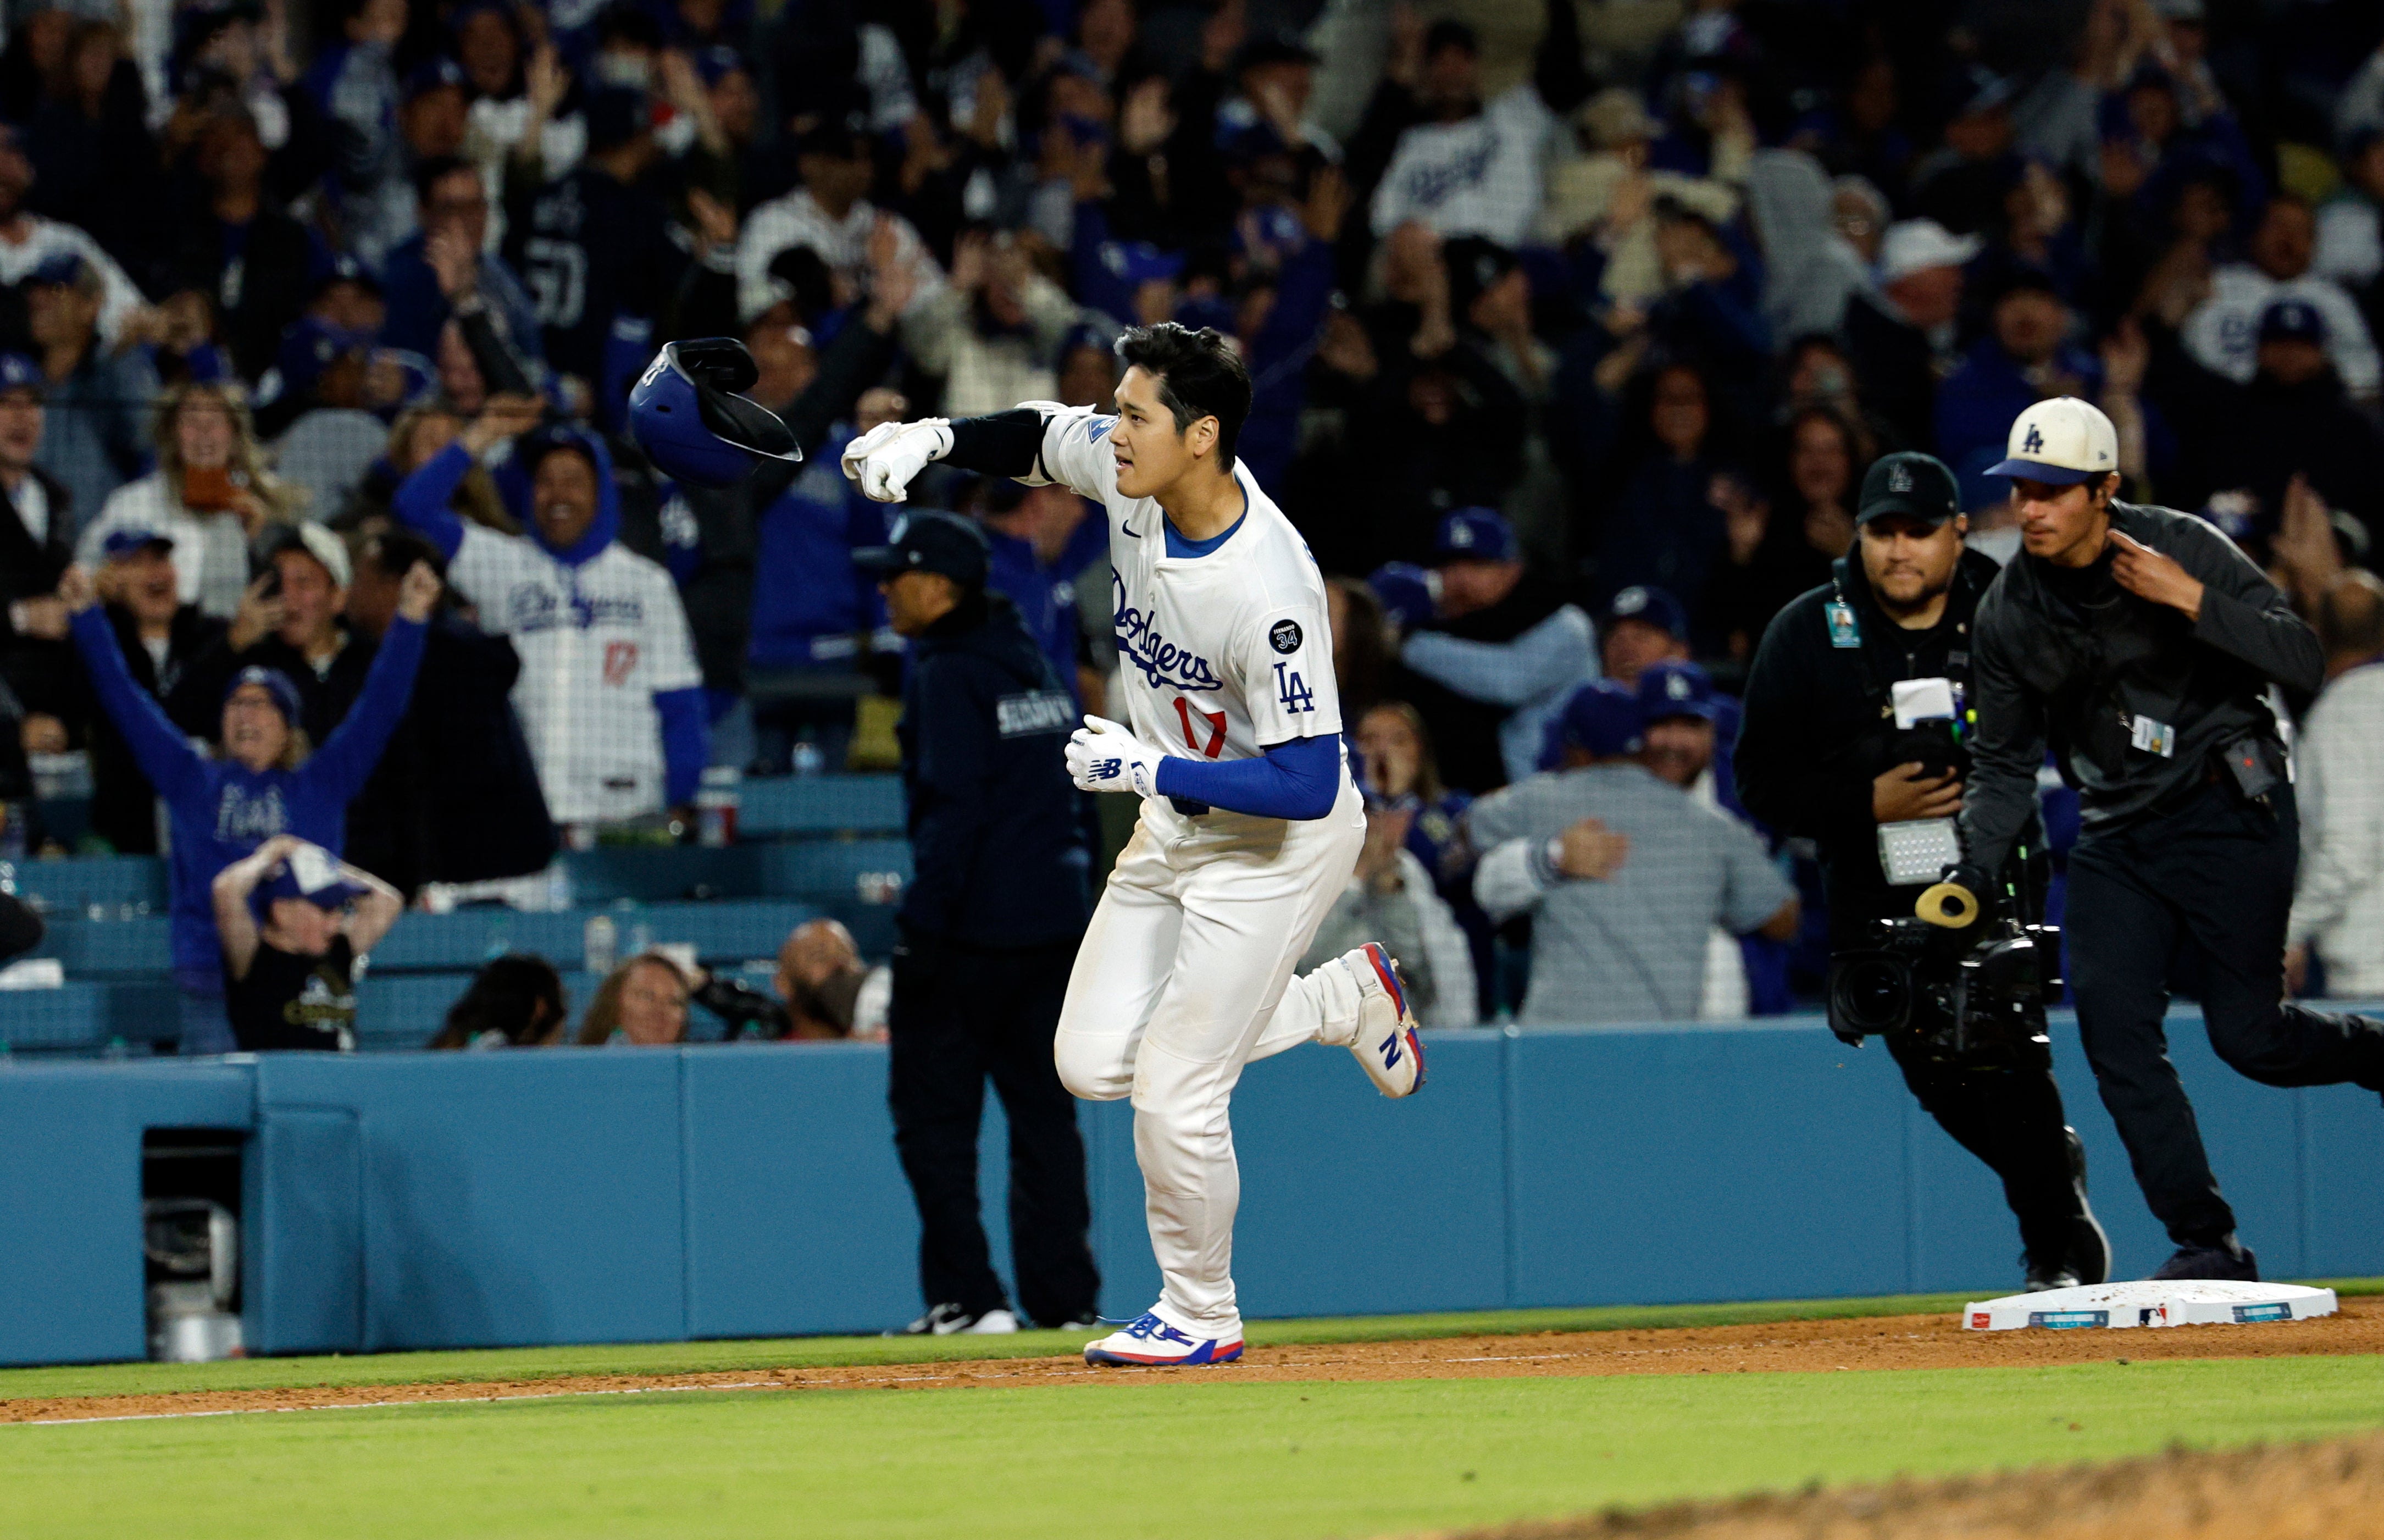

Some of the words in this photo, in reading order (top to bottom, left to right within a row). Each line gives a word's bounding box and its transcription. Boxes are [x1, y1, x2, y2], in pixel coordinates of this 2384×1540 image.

[2023, 423, 2044, 454] LA
[1111, 564, 1224, 691] Dodgers
[1273, 624, 1295, 635] FERNANDO
[1276, 630, 1298, 650] 34
[1273, 661, 1315, 714] LA
[1173, 696, 1228, 759] 17
[1378, 1030, 1402, 1072] N
